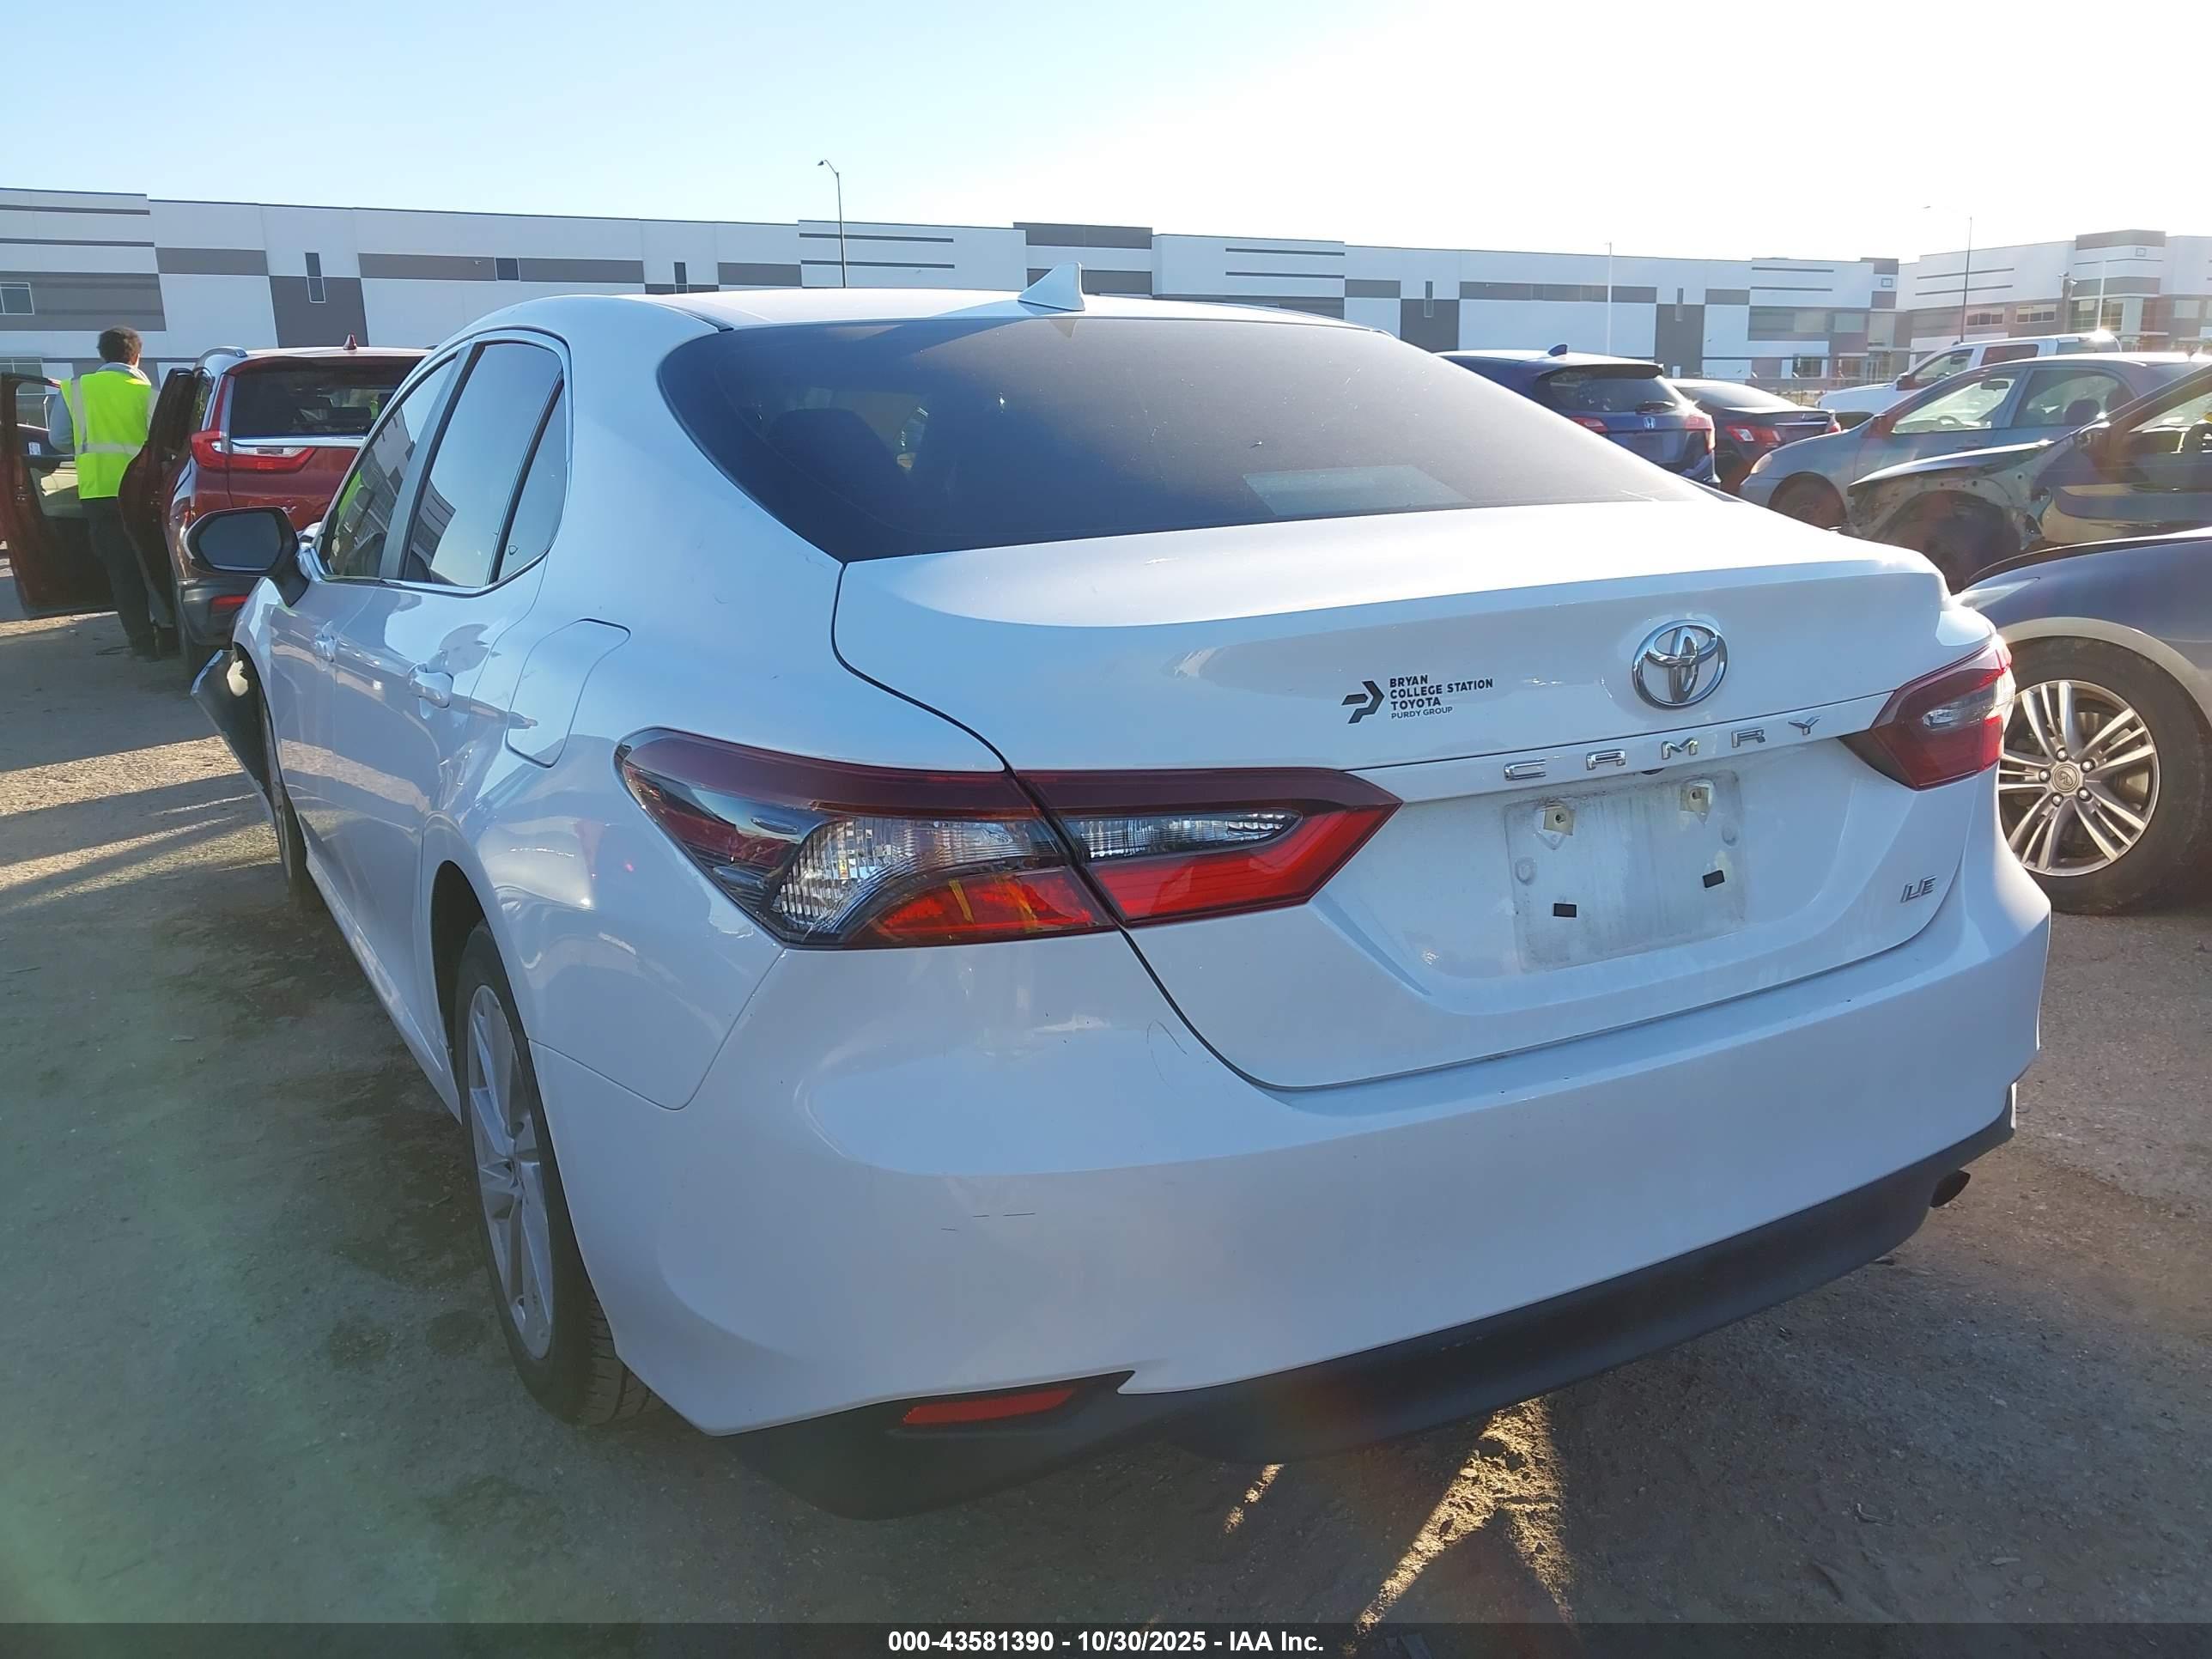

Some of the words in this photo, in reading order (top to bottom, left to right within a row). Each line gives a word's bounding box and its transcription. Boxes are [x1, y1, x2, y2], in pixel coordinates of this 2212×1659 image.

[1389, 674, 1428, 688] BRYAN
[1389, 684, 1443, 699] COLLEGE
[1447, 678, 1493, 693] STATION
[1391, 696, 1441, 711] TOYOTA
[1391, 710, 1422, 720] PURDY
[1423, 707, 1453, 716] GROUP
[1504, 715, 1820, 781] CAMRY
[1900, 875, 1938, 903] LE
